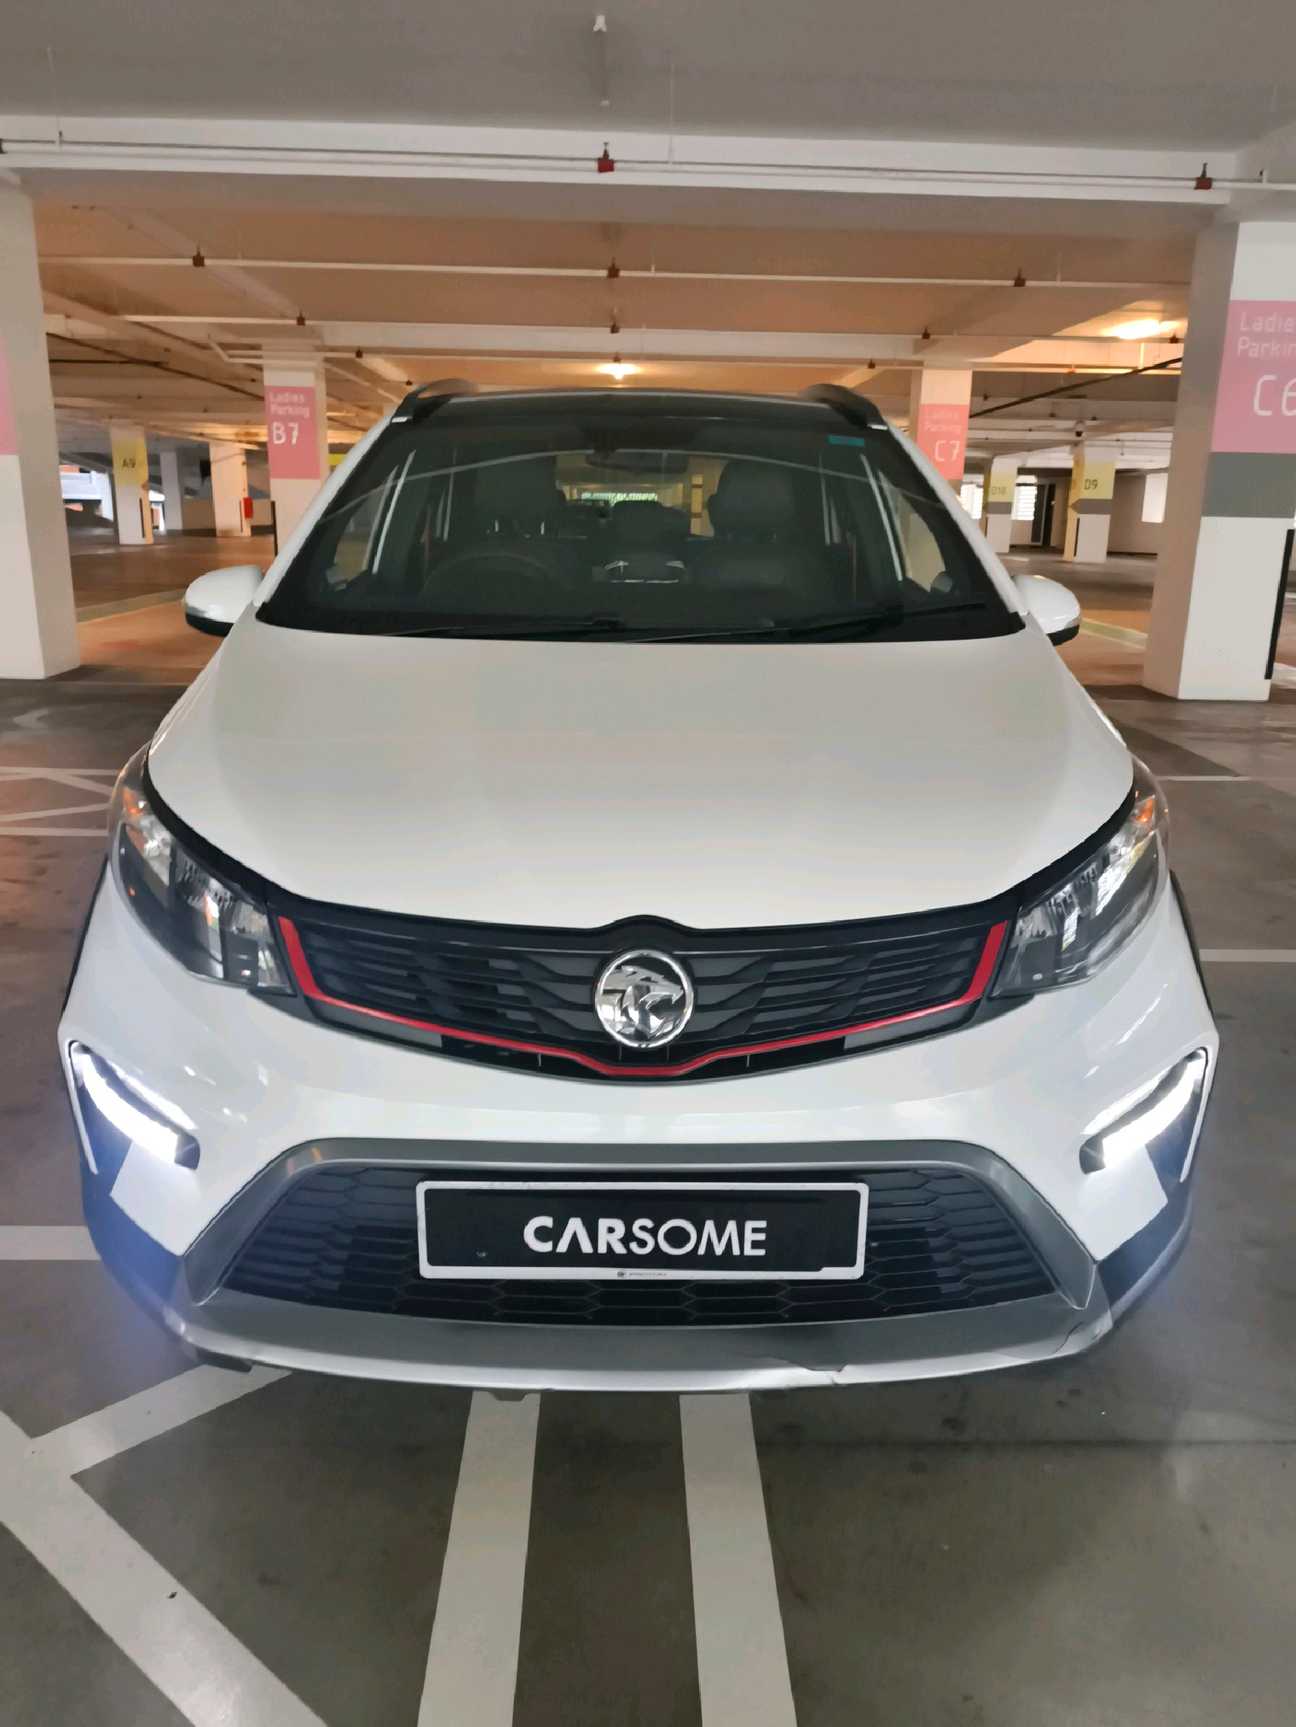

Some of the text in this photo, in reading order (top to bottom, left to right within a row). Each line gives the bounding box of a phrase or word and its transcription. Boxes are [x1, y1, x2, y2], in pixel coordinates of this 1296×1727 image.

[272, 421, 299, 445] B7
[935, 439, 961, 462] C7
[1084, 478, 1099, 491] D9
[523, 1216, 768, 1257] CARSOME
